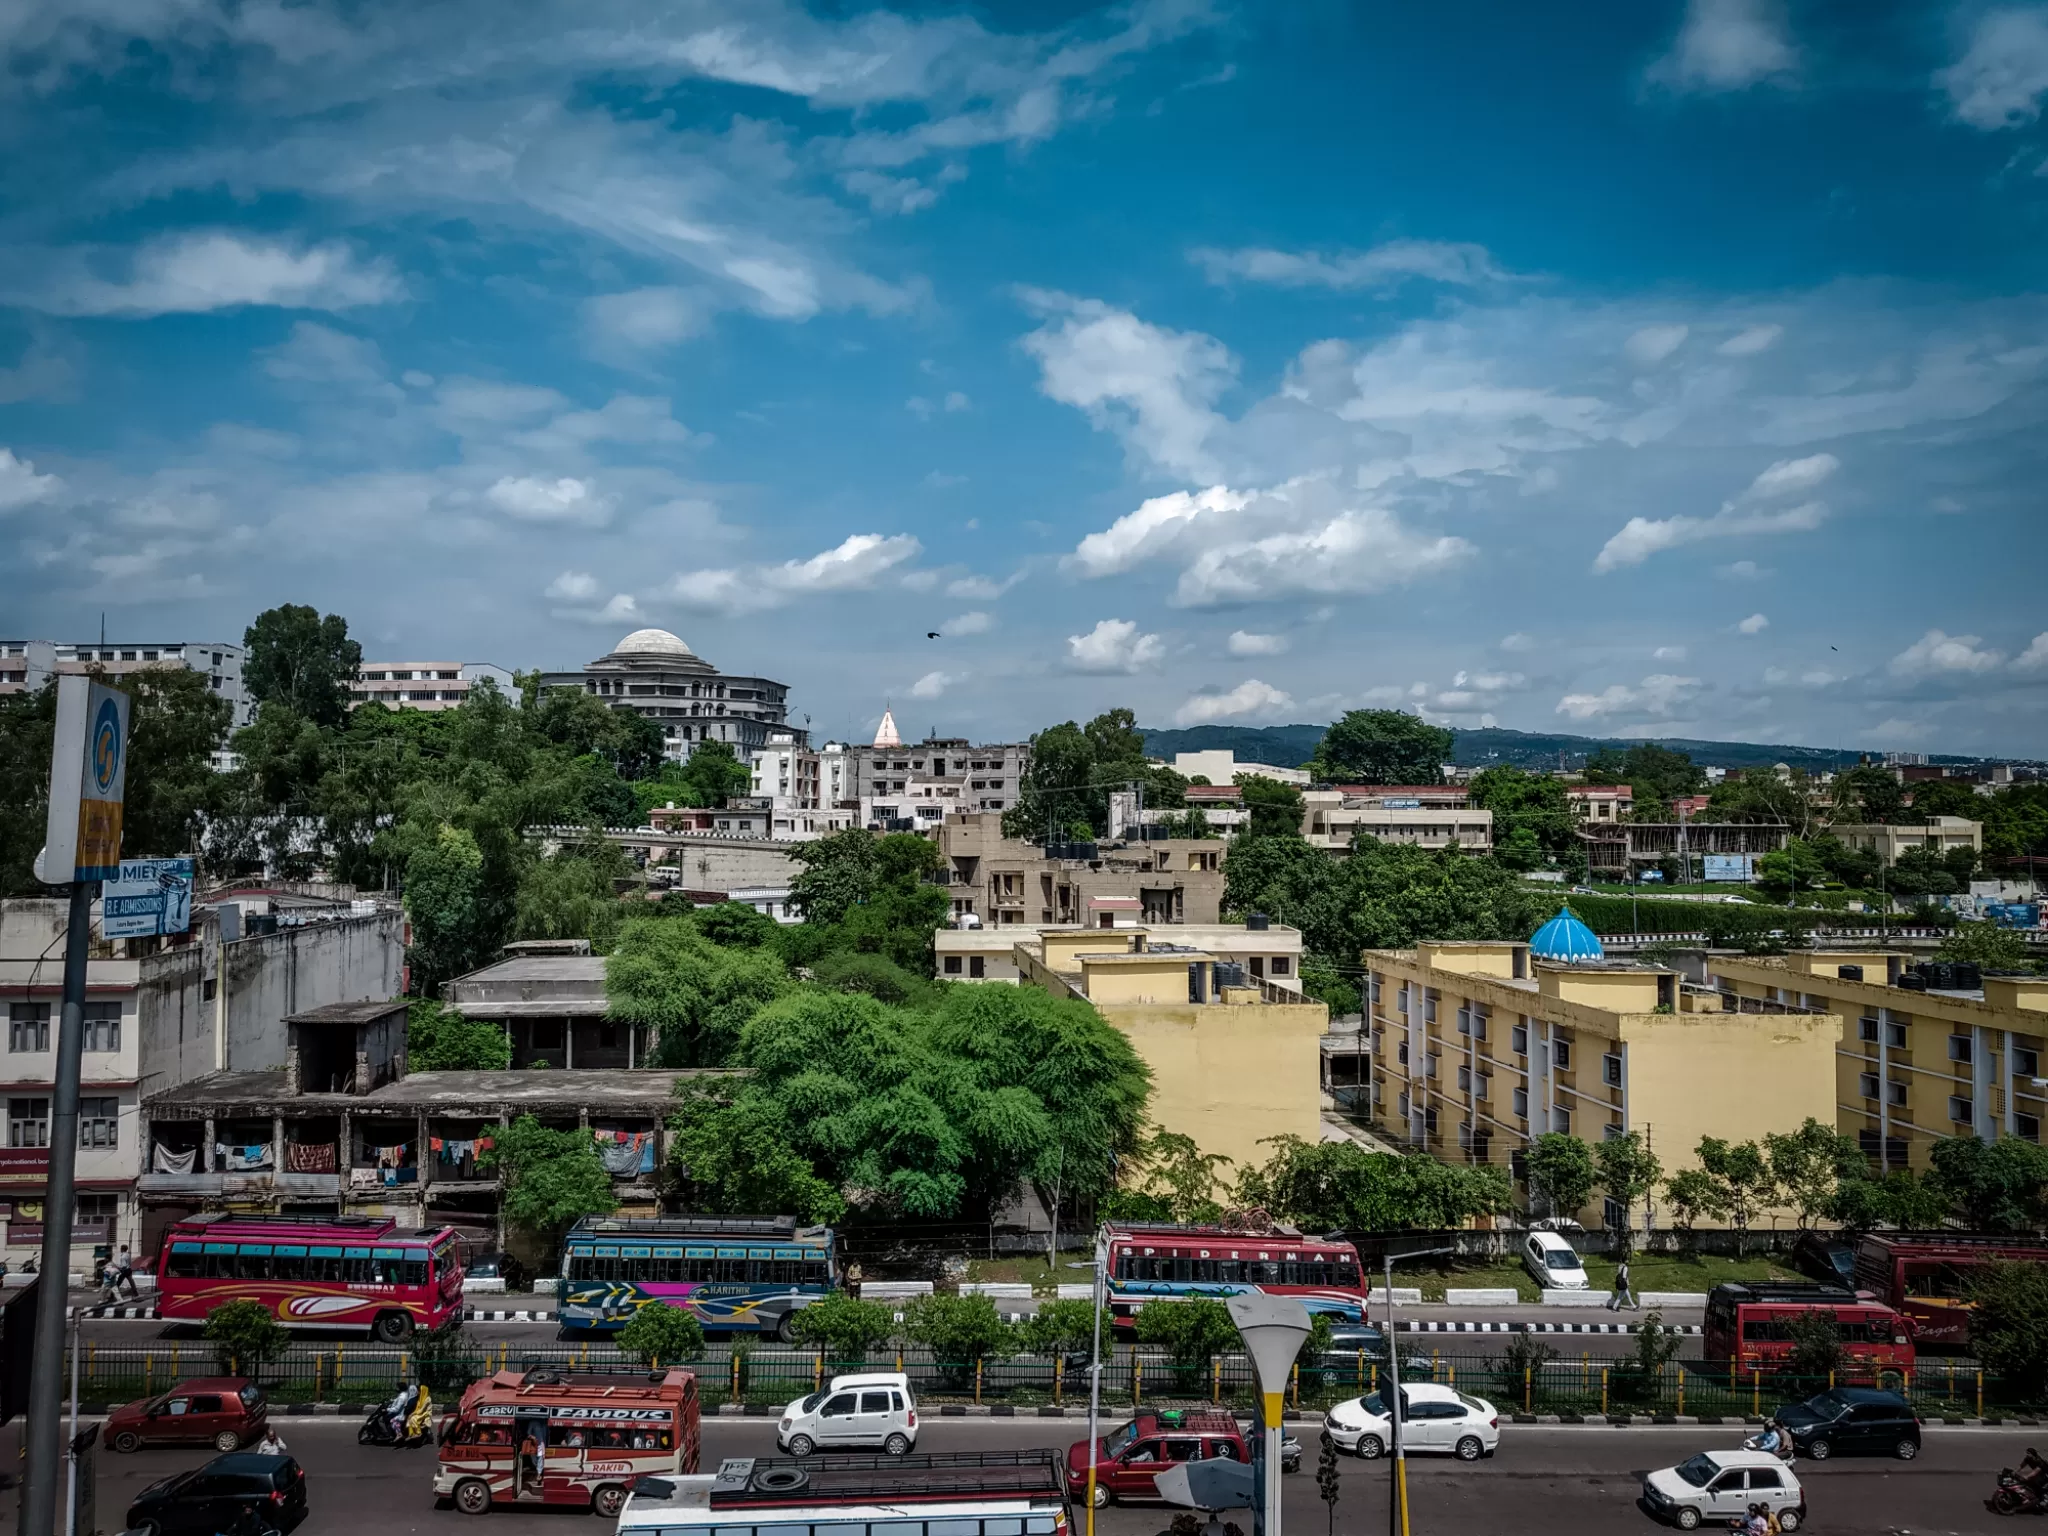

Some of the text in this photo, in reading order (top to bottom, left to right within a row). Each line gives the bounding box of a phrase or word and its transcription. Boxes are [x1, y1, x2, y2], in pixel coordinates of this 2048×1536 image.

[106, 897, 163, 915] B.E ADMISSIONS
[37, 1157, 50, 1165] ban
[1121, 1247, 1351, 1263] SPIDERMAN
[1747, 1345, 1780, 1353] MOHIT
[557, 1407, 665, 1419] FAMOUS
[446, 1448, 464, 1458] Star
